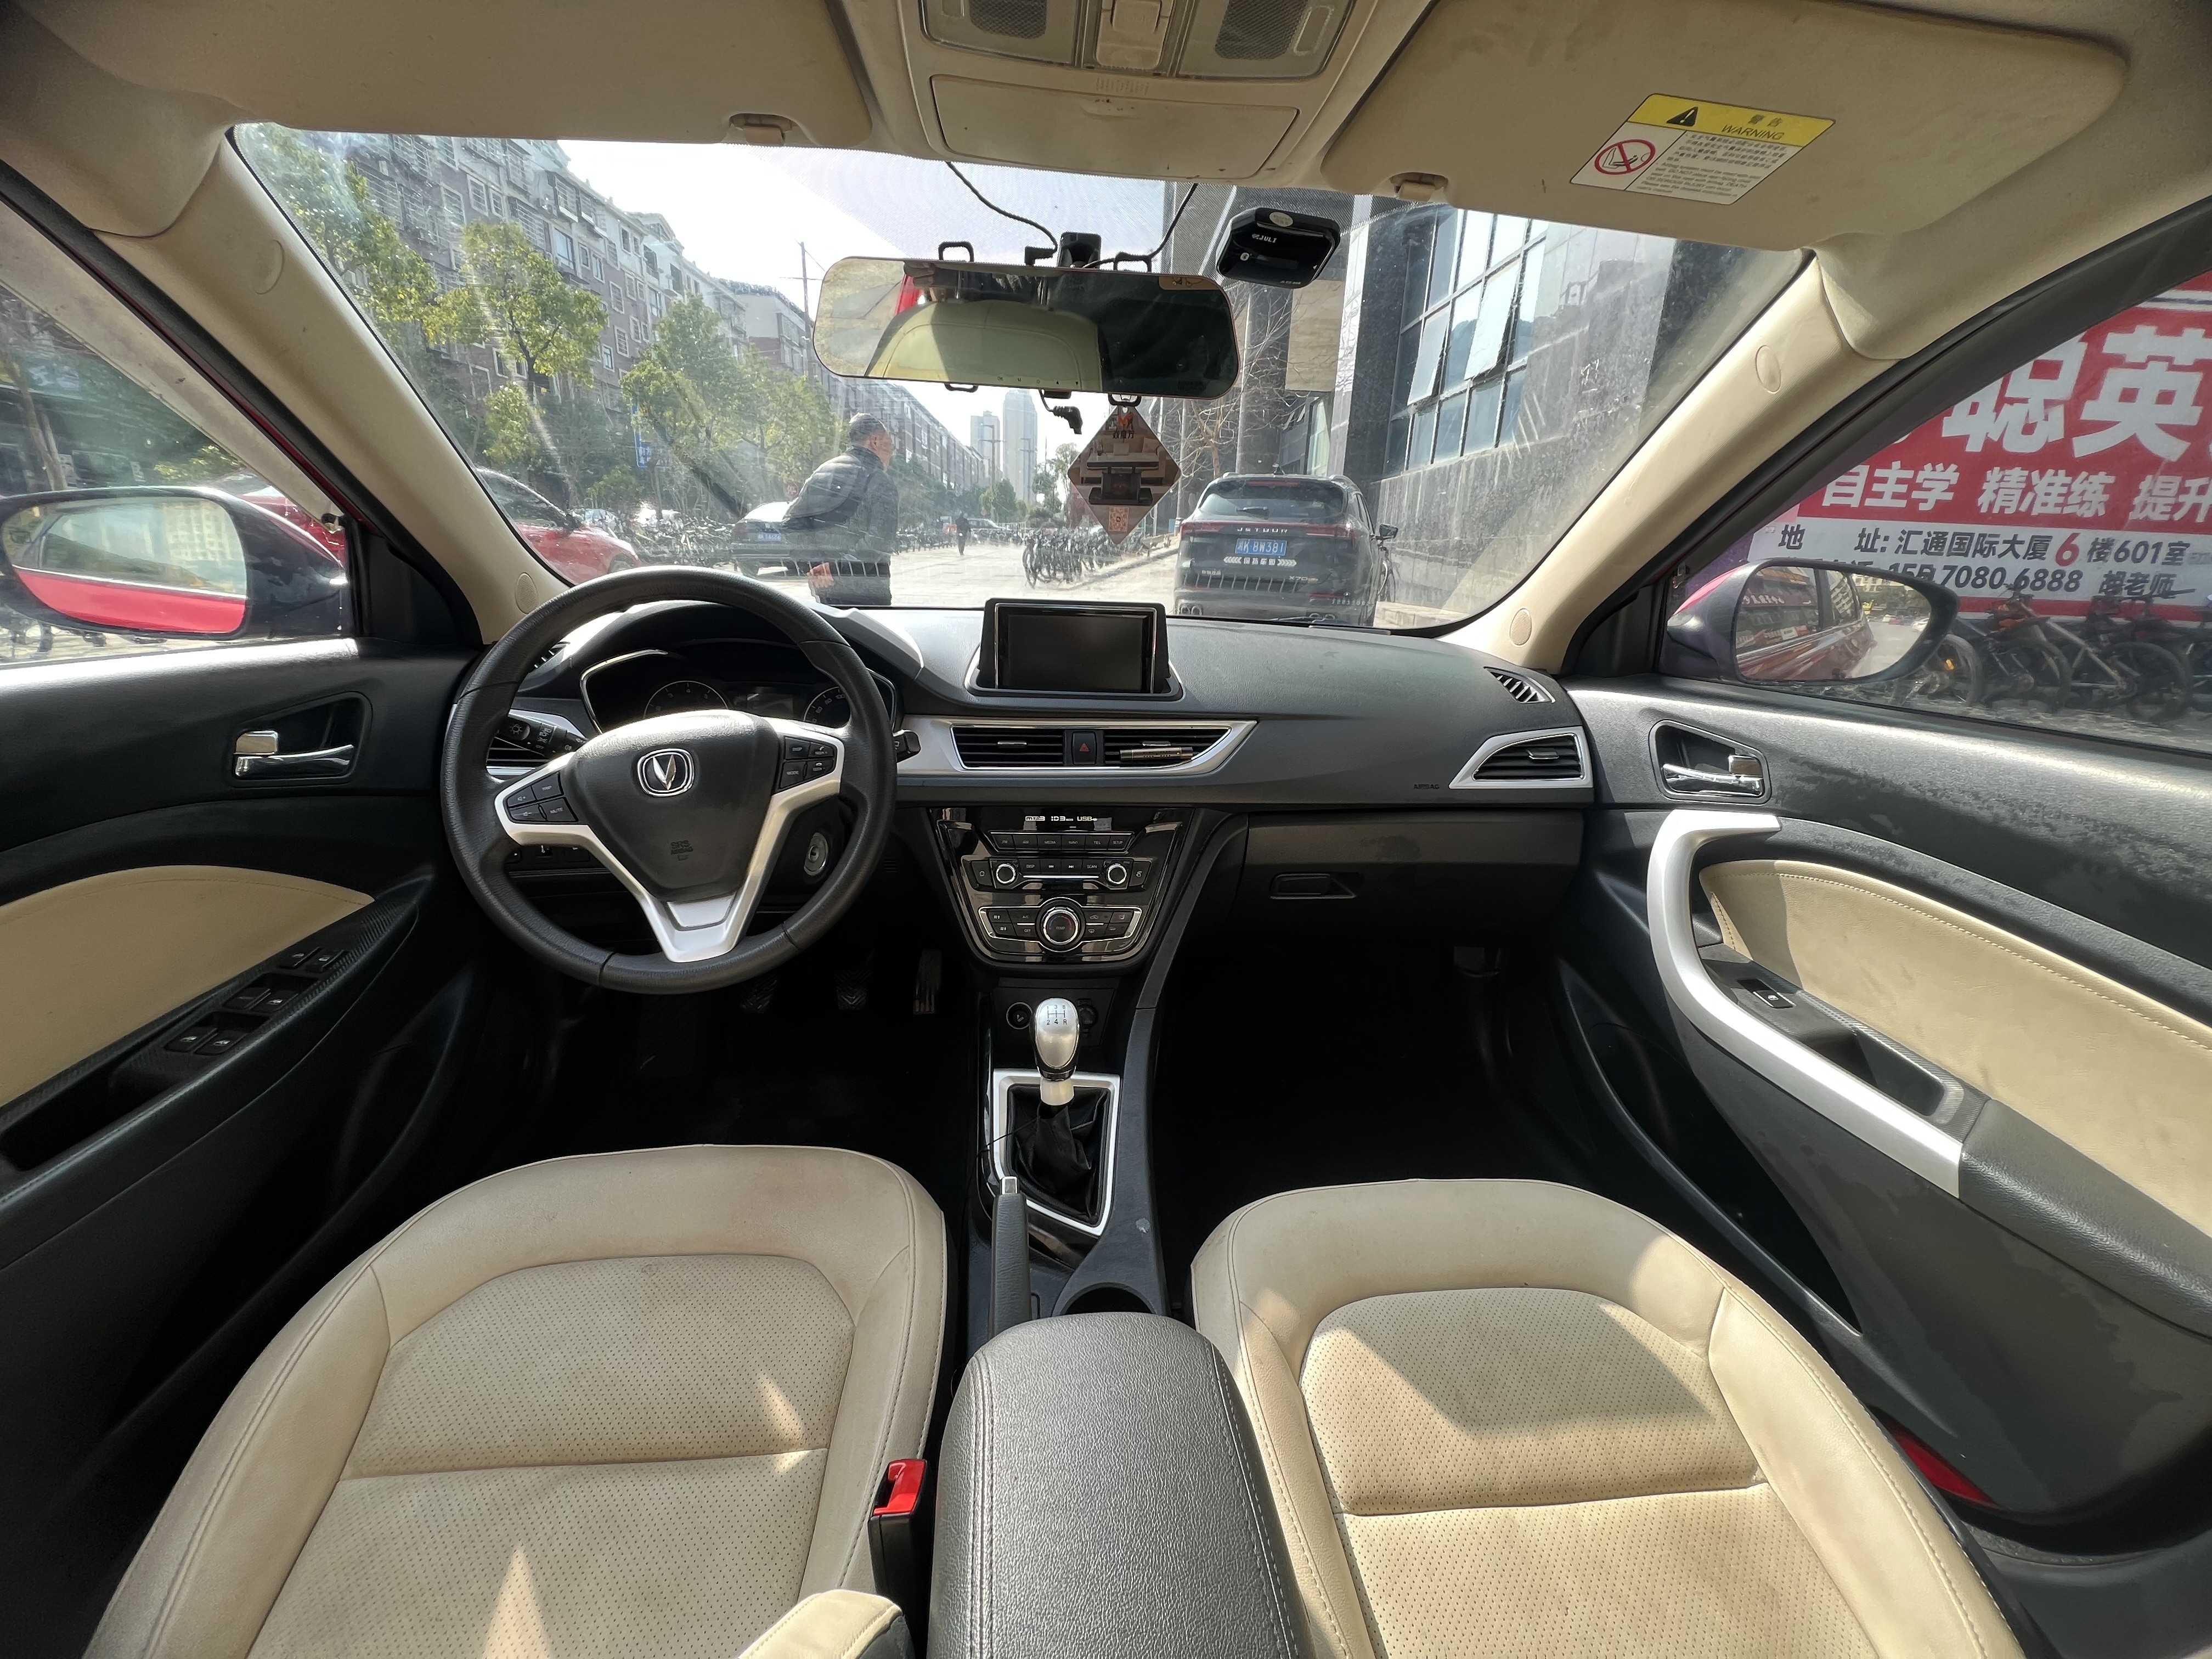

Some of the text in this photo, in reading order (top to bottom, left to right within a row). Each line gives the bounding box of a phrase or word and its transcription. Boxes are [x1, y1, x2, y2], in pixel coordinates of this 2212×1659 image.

[1722, 125, 1785, 140] WARNING
[1822, 460, 1960, 511] 自主学
[1977, 466, 2116, 518] 精准练
[1778, 524, 1805, 550] 地
